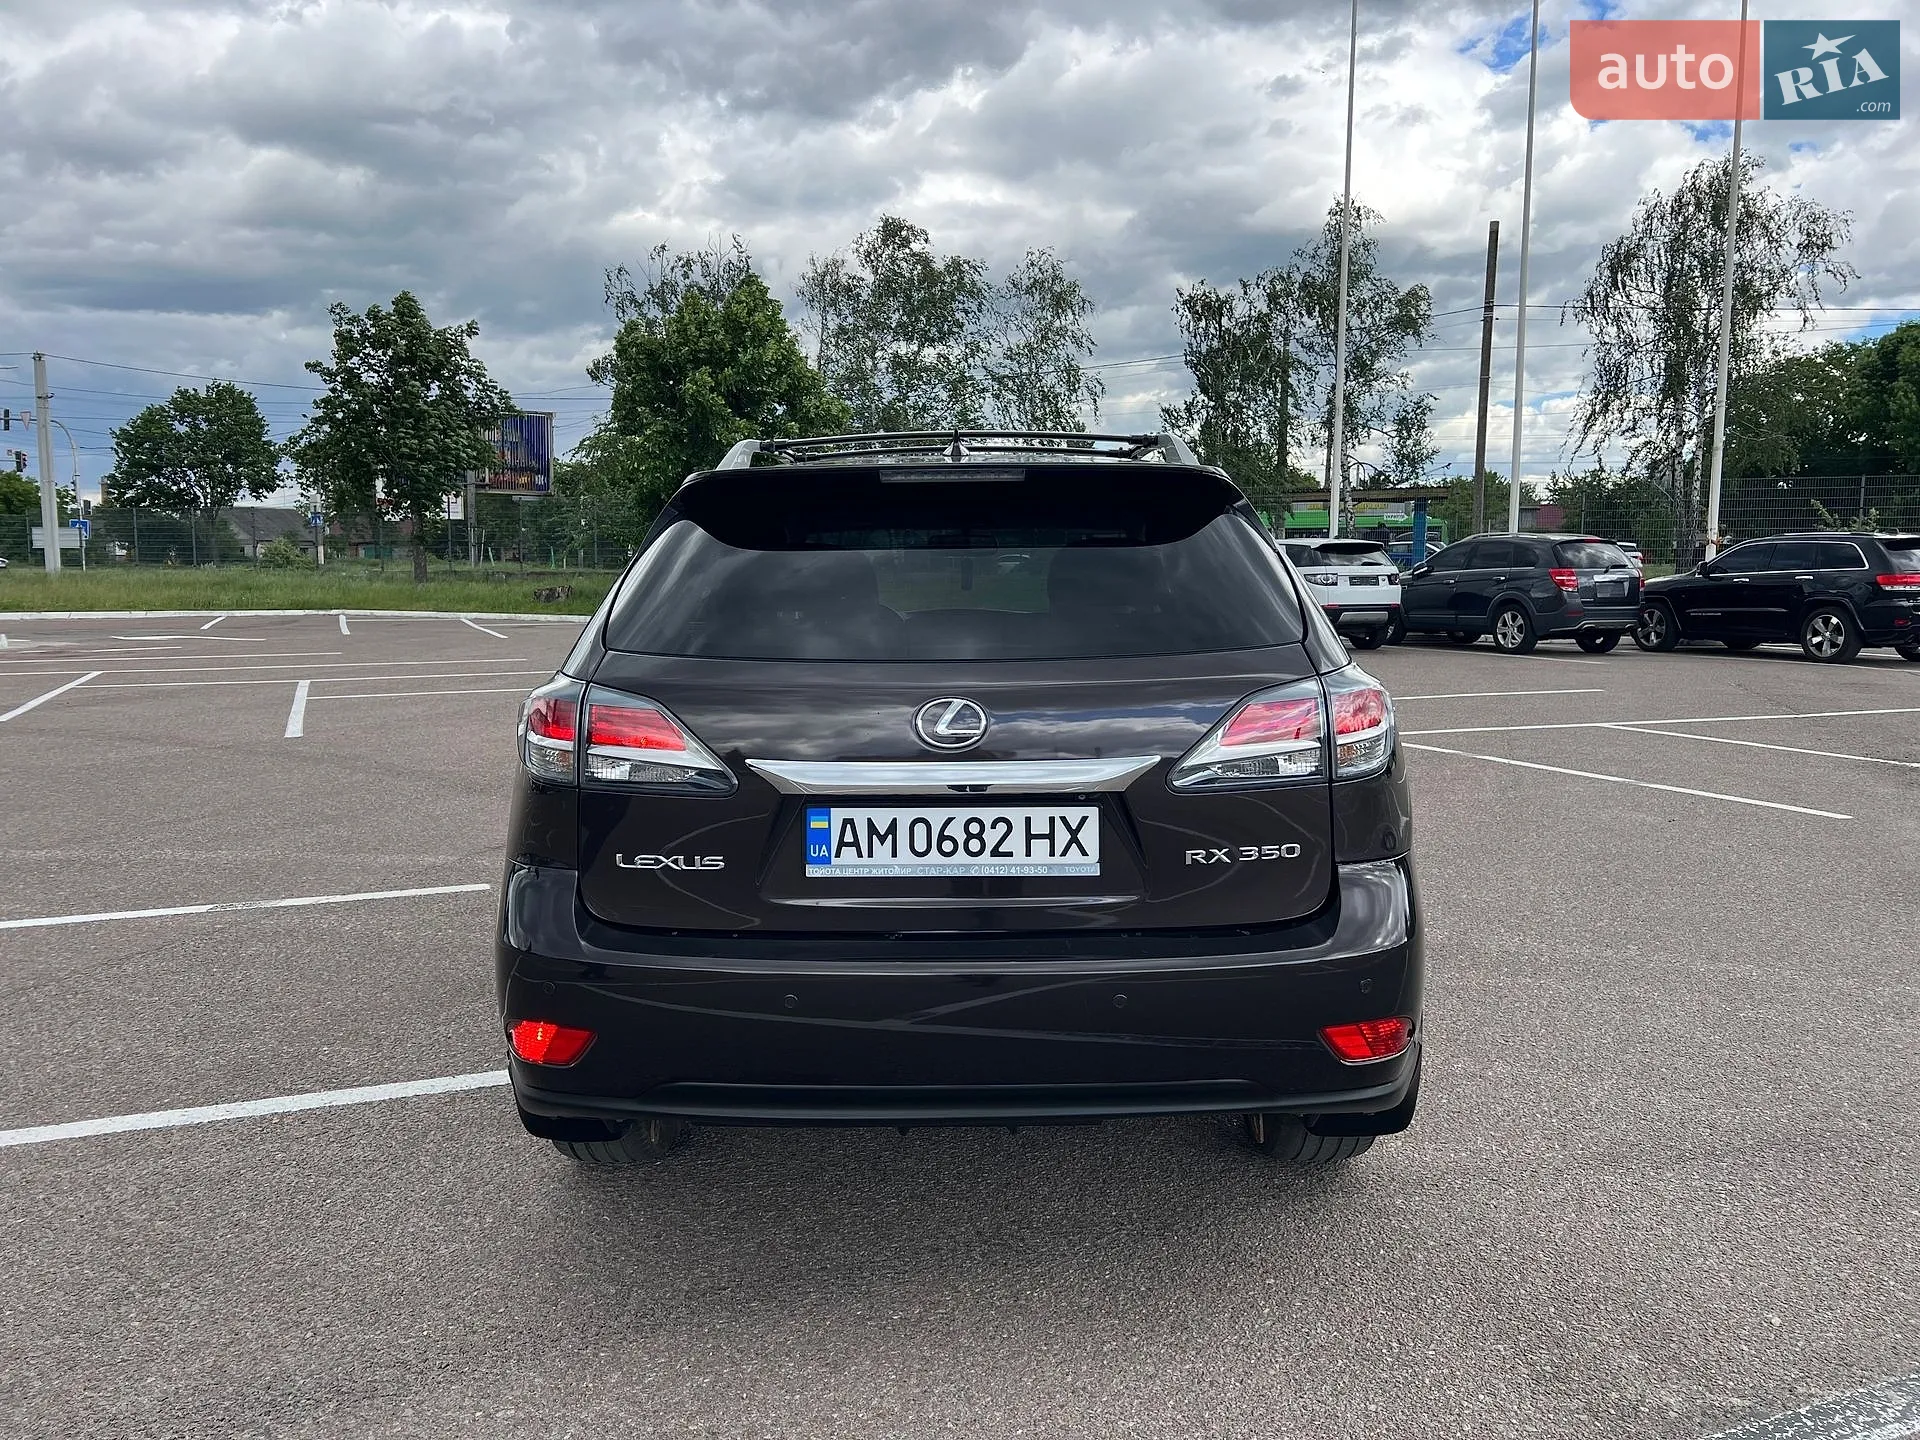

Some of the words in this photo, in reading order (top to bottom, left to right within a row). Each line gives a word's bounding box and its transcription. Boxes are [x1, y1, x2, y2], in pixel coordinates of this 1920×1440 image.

[834, 817, 898, 859] AM
[908, 816, 1014, 858] 0682
[810, 844, 829, 857] UA
[1185, 848, 1232, 865] RX
[1238, 843, 1301, 861] 350
[615, 853, 725, 870] LEXUS
[808, 865, 840, 875] ТОЙОТА
[843, 867, 869, 876] ЦЕНТР
[871, 867, 912, 875] ЖИТОМИР
[916, 866, 965, 875] СТАР-КАР
[981, 866, 1008, 875] (0412)
[1010, 866, 1048, 874] 41-93-50
